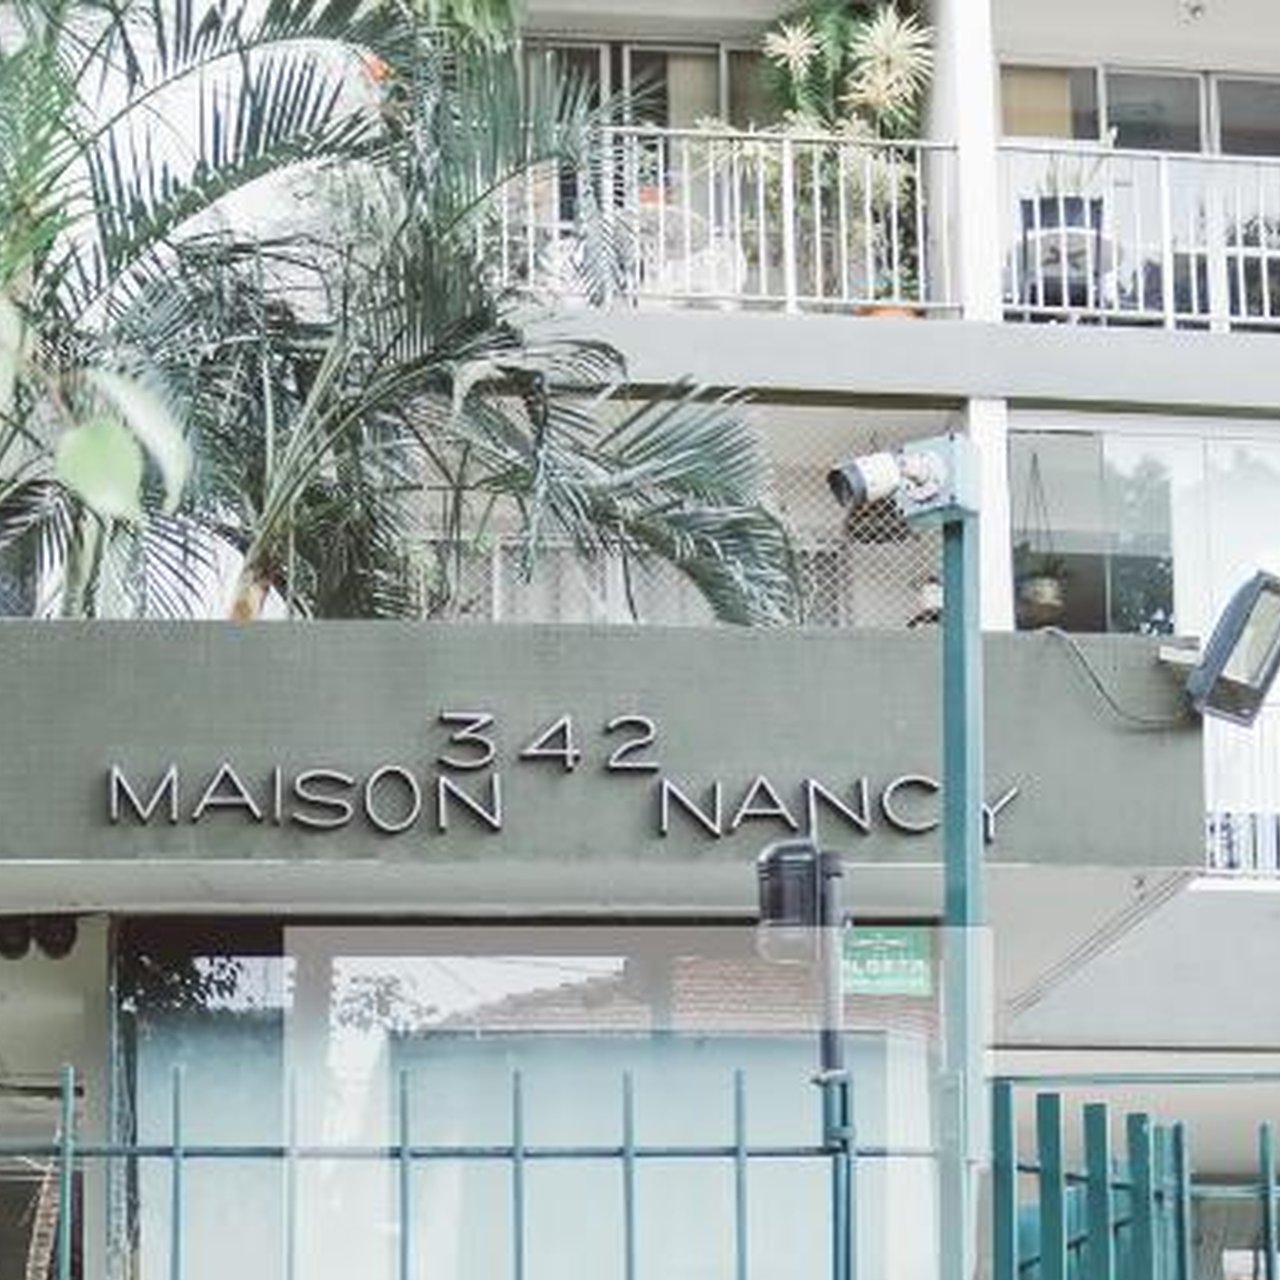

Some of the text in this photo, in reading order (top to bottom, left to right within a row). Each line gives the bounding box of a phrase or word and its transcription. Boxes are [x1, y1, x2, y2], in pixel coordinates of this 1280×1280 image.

[437, 711, 660, 772] 342
[108, 762, 1020, 843] MAISON NANCY
